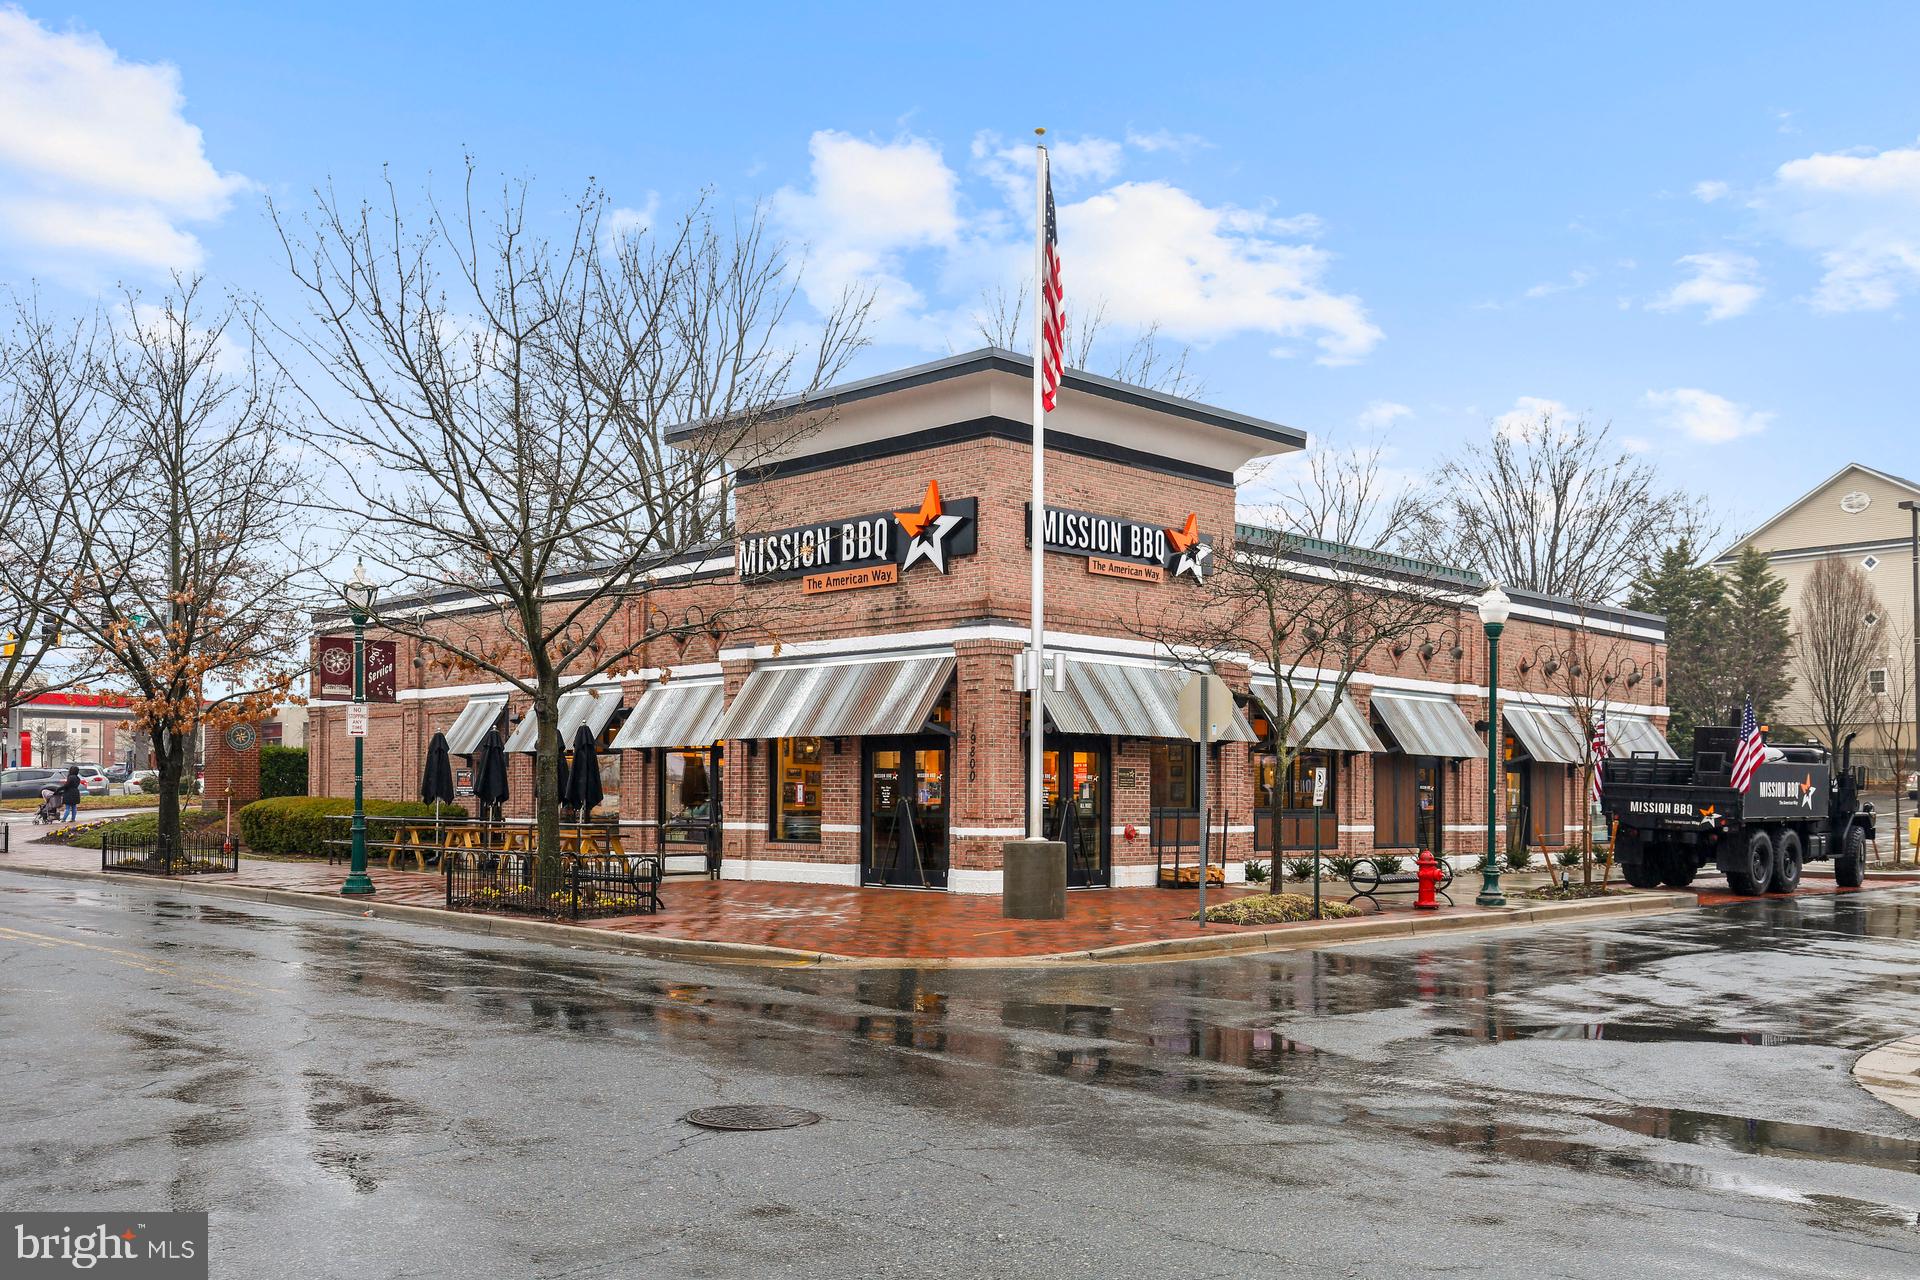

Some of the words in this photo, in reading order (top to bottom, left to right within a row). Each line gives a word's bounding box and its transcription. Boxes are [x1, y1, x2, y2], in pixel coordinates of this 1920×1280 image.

[1042, 509, 1122, 553] MISSION
[1130, 525, 1165, 564] BBQ
[739, 526, 831, 576] MISSION
[842, 517, 888, 561] BBQ
[1092, 560, 1106, 572] The
[1108, 562, 1143, 577] American
[806, 578, 822, 590] The
[825, 572, 869, 588] American
[368, 662, 393, 684] Service
[1759, 781, 1786, 798] MISSION
[1787, 781, 1799, 800] BBQ
[1630, 801, 1671, 814] MISSION
[1673, 803, 1693, 817] BBQ
